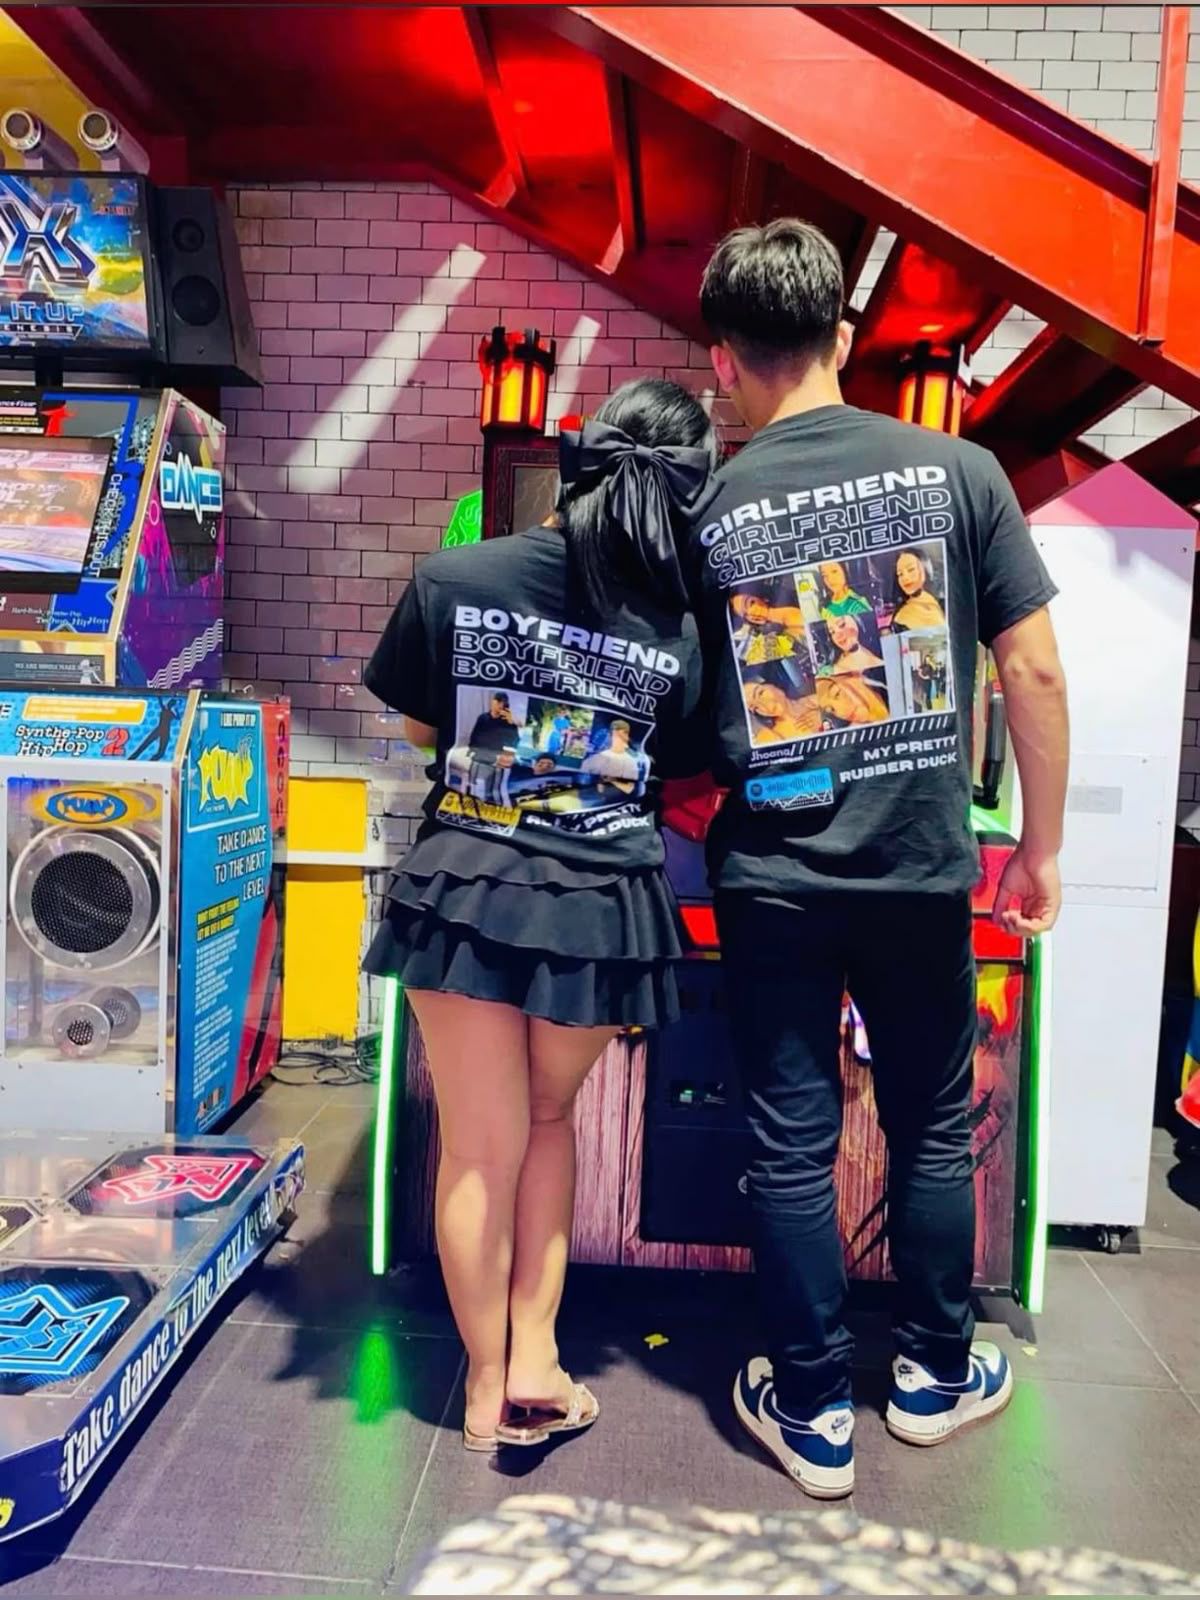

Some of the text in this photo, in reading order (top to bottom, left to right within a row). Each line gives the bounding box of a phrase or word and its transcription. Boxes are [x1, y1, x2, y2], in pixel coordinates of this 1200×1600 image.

[10, 301, 85, 322] IT UP
[700, 465, 947, 547] GIRLFRIEND
[708, 488, 951, 569] GIRLFRIEND
[718, 512, 954, 588] GIRLFRIEND
[455, 605, 681, 676] BOYFRIEND
[453, 630, 671, 695] BOYFRIEND
[101, 727, 129, 757] 2
[751, 748, 791, 761] Jhoana
[863, 734, 958, 761] MY PRETTY
[839, 752, 957, 783] RUBBER DUCK
[217, 825, 267, 854] TAKE DANCE
[608, 816, 650, 833] DUCK
[215, 851, 267, 884] TO THE NEXT
[243, 877, 265, 901] LEVEL
[59, 1394, 114, 1493] Take
[119, 1325, 171, 1418] dance
[174, 1303, 189, 1345] to
[192, 1267, 213, 1318] the
[216, 1225, 242, 1289] next
